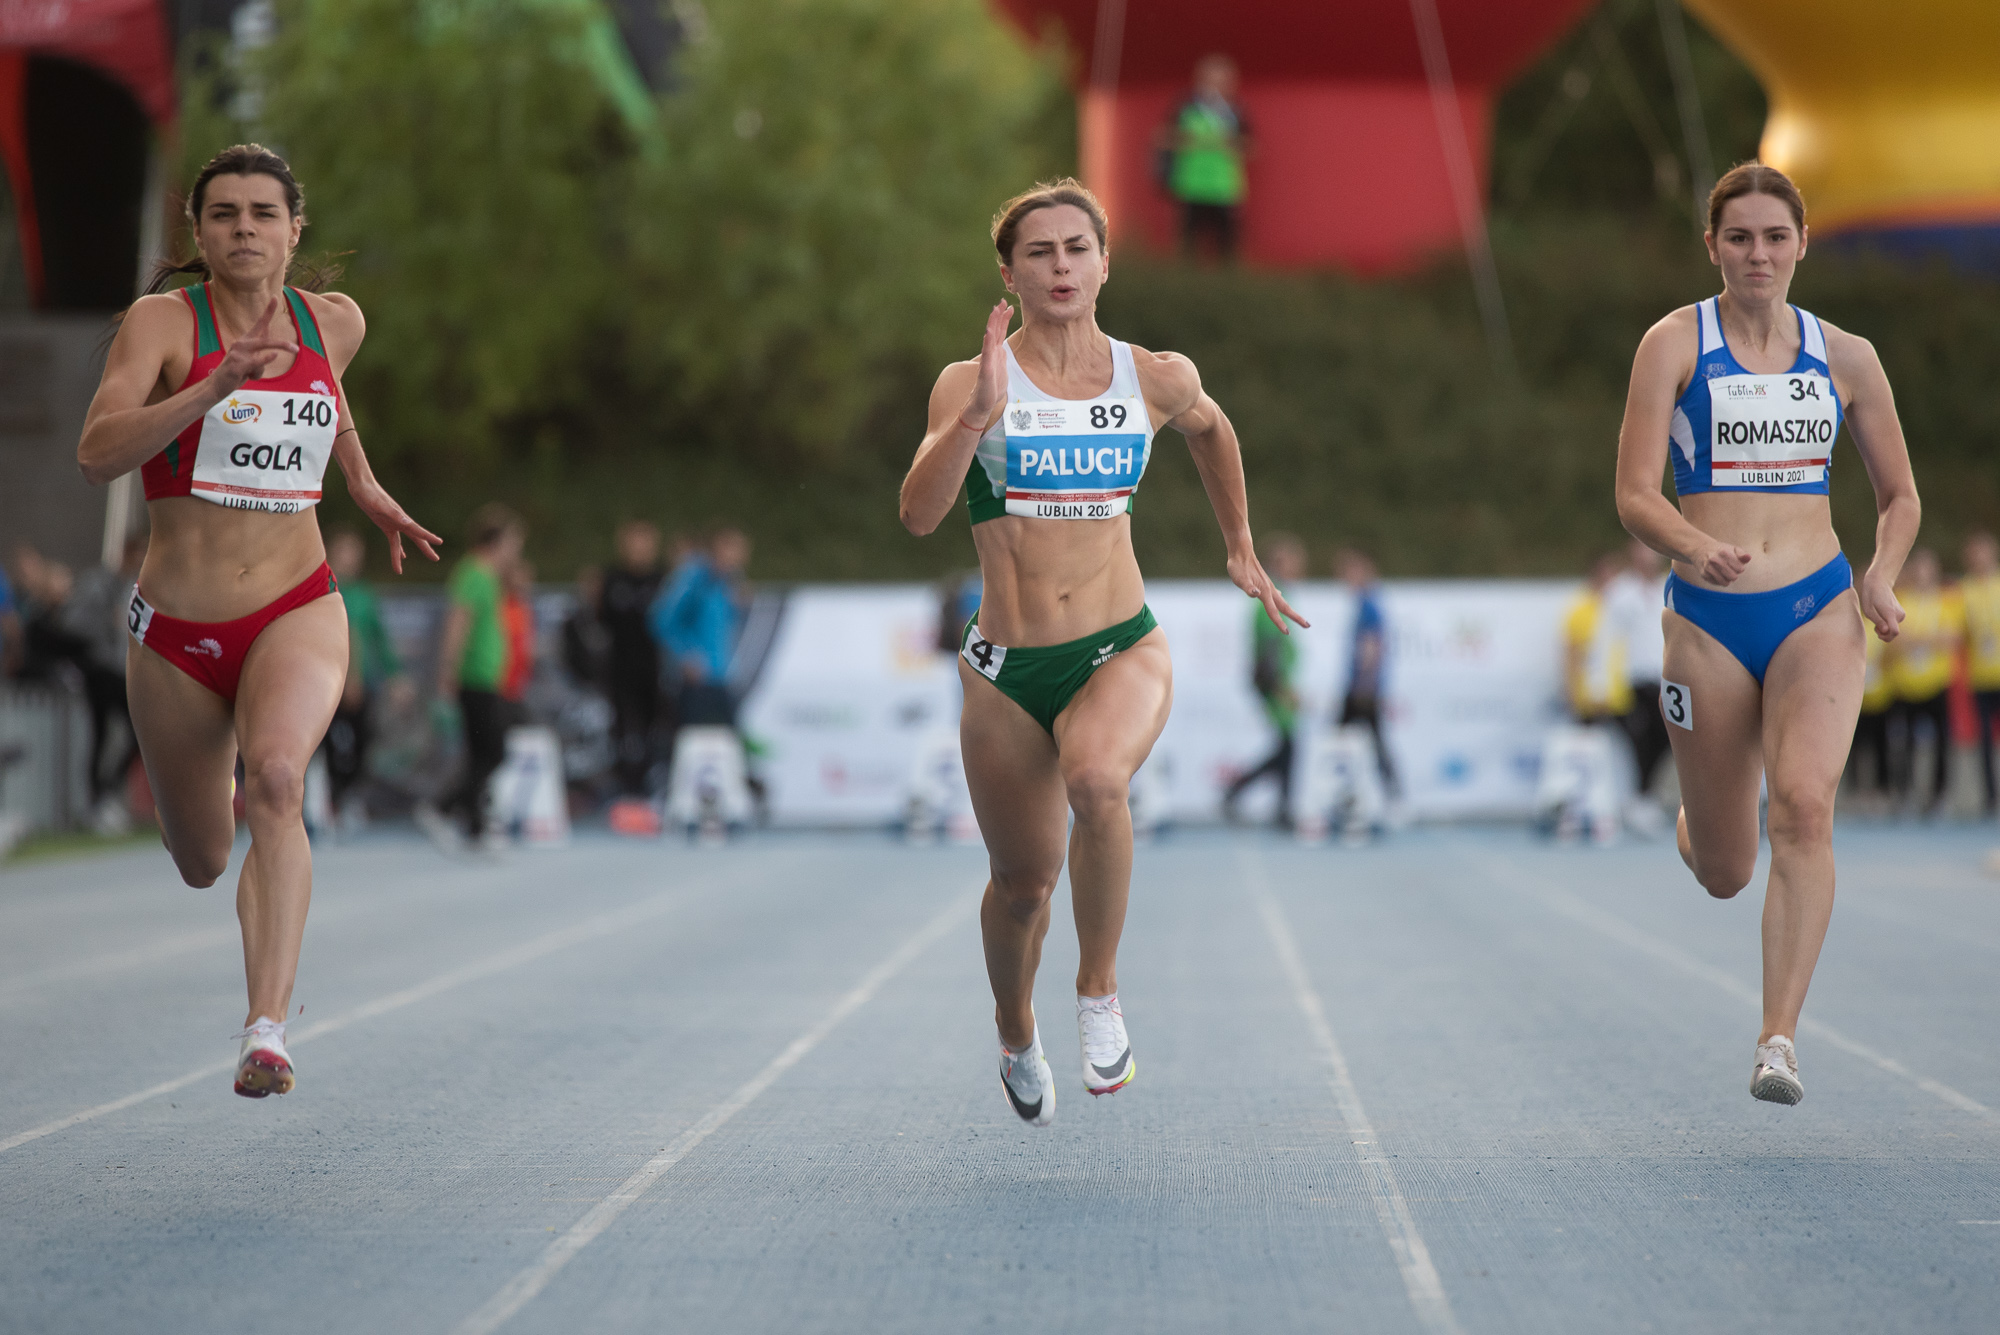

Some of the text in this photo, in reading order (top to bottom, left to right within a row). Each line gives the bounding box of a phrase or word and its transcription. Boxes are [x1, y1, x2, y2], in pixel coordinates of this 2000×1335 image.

[1789, 378, 1820, 401] 34
[231, 407, 255, 420] LOTTO
[282, 399, 332, 427] 140
[1090, 404, 1127, 429] 89
[1718, 420, 1832, 444] ROMASZKO
[230, 443, 302, 471] GOLA
[1020, 448, 1133, 476] PALUCH
[1742, 470, 1805, 483] LUBLIN 2021
[223, 497, 299, 513] LUBLIN 2021
[1037, 504, 1113, 516] LUBLIN 2021
[128, 595, 145, 634] 5
[970, 640, 994, 671] 4
[1092, 651, 1120, 666] erim
[1666, 685, 1685, 723] 3
